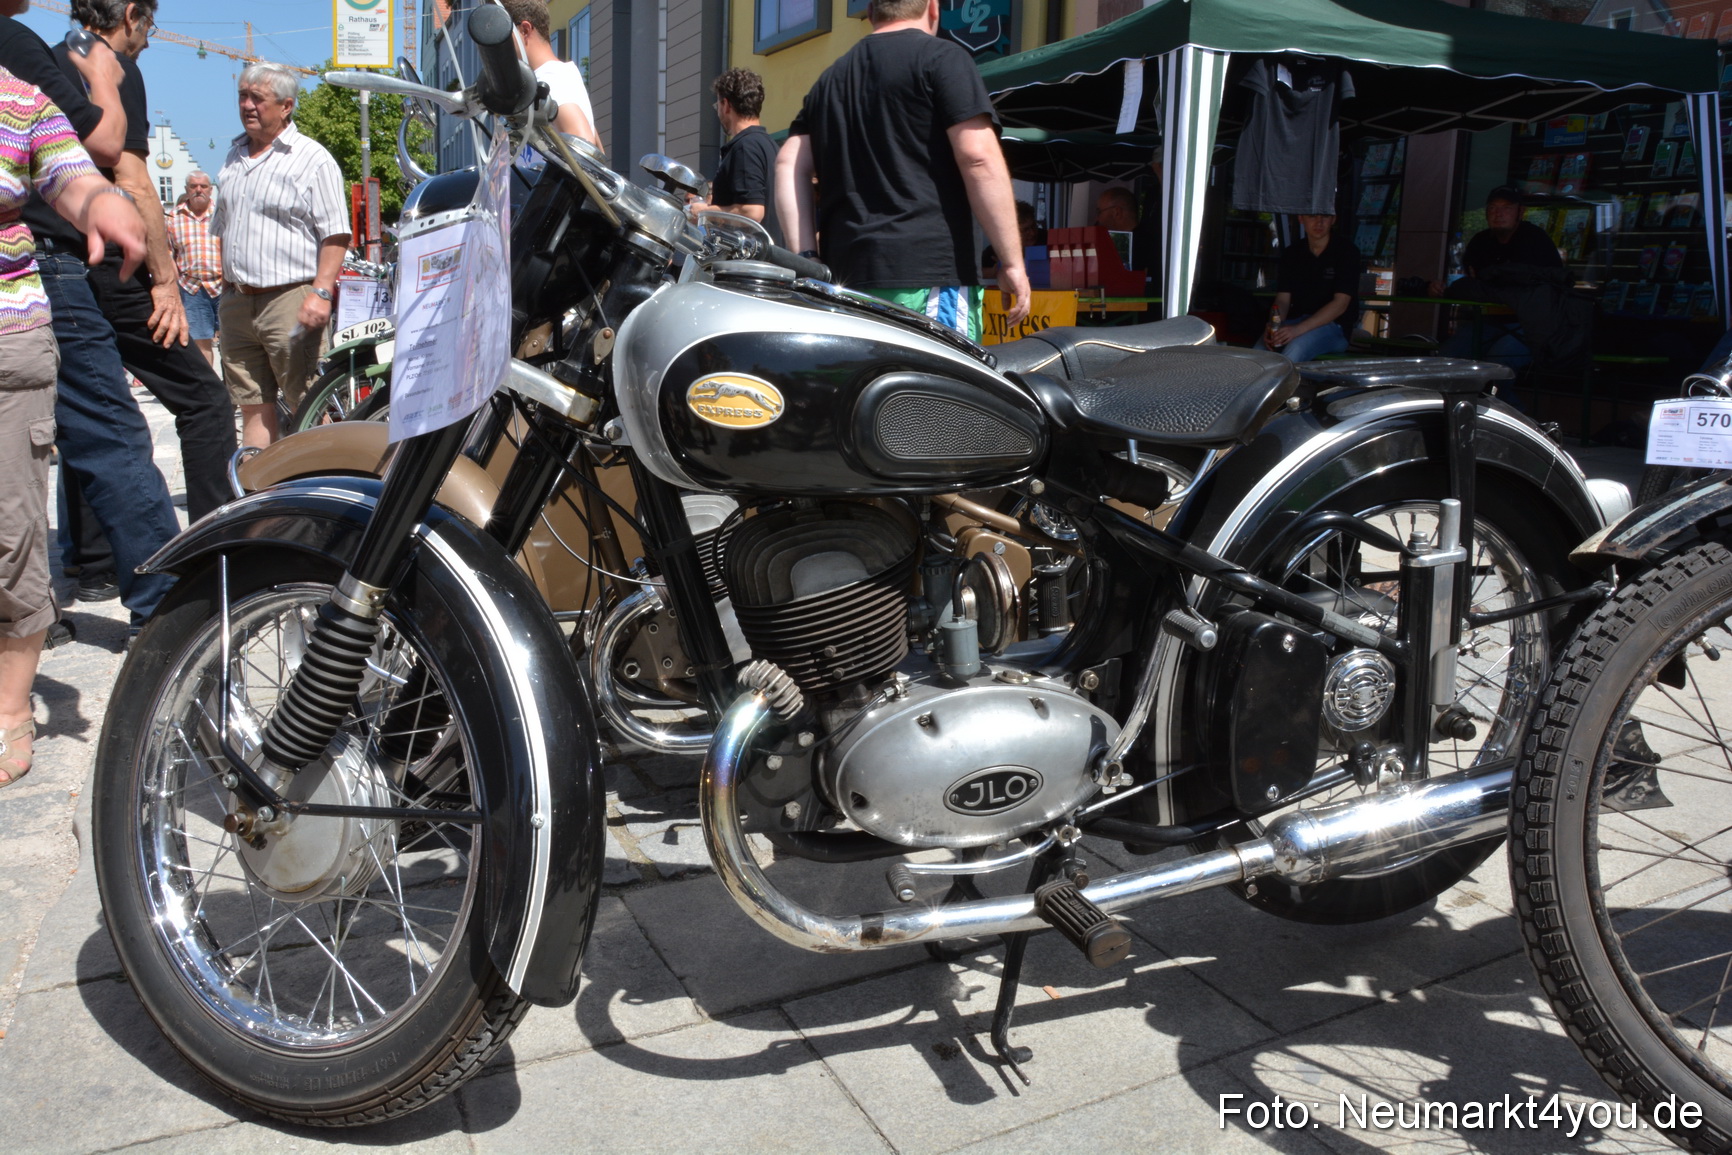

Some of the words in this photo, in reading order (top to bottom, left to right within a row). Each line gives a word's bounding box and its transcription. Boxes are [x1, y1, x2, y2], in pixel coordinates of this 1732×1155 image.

[961, 0, 991, 33] G2
[341, 328, 360, 343] SL
[364, 321, 386, 335] 102
[982, 303, 1051, 343] xpress
[697, 403, 764, 419] EXPRESS
[1696, 412, 1732, 428] 570
[963, 775, 1028, 807] JLO
